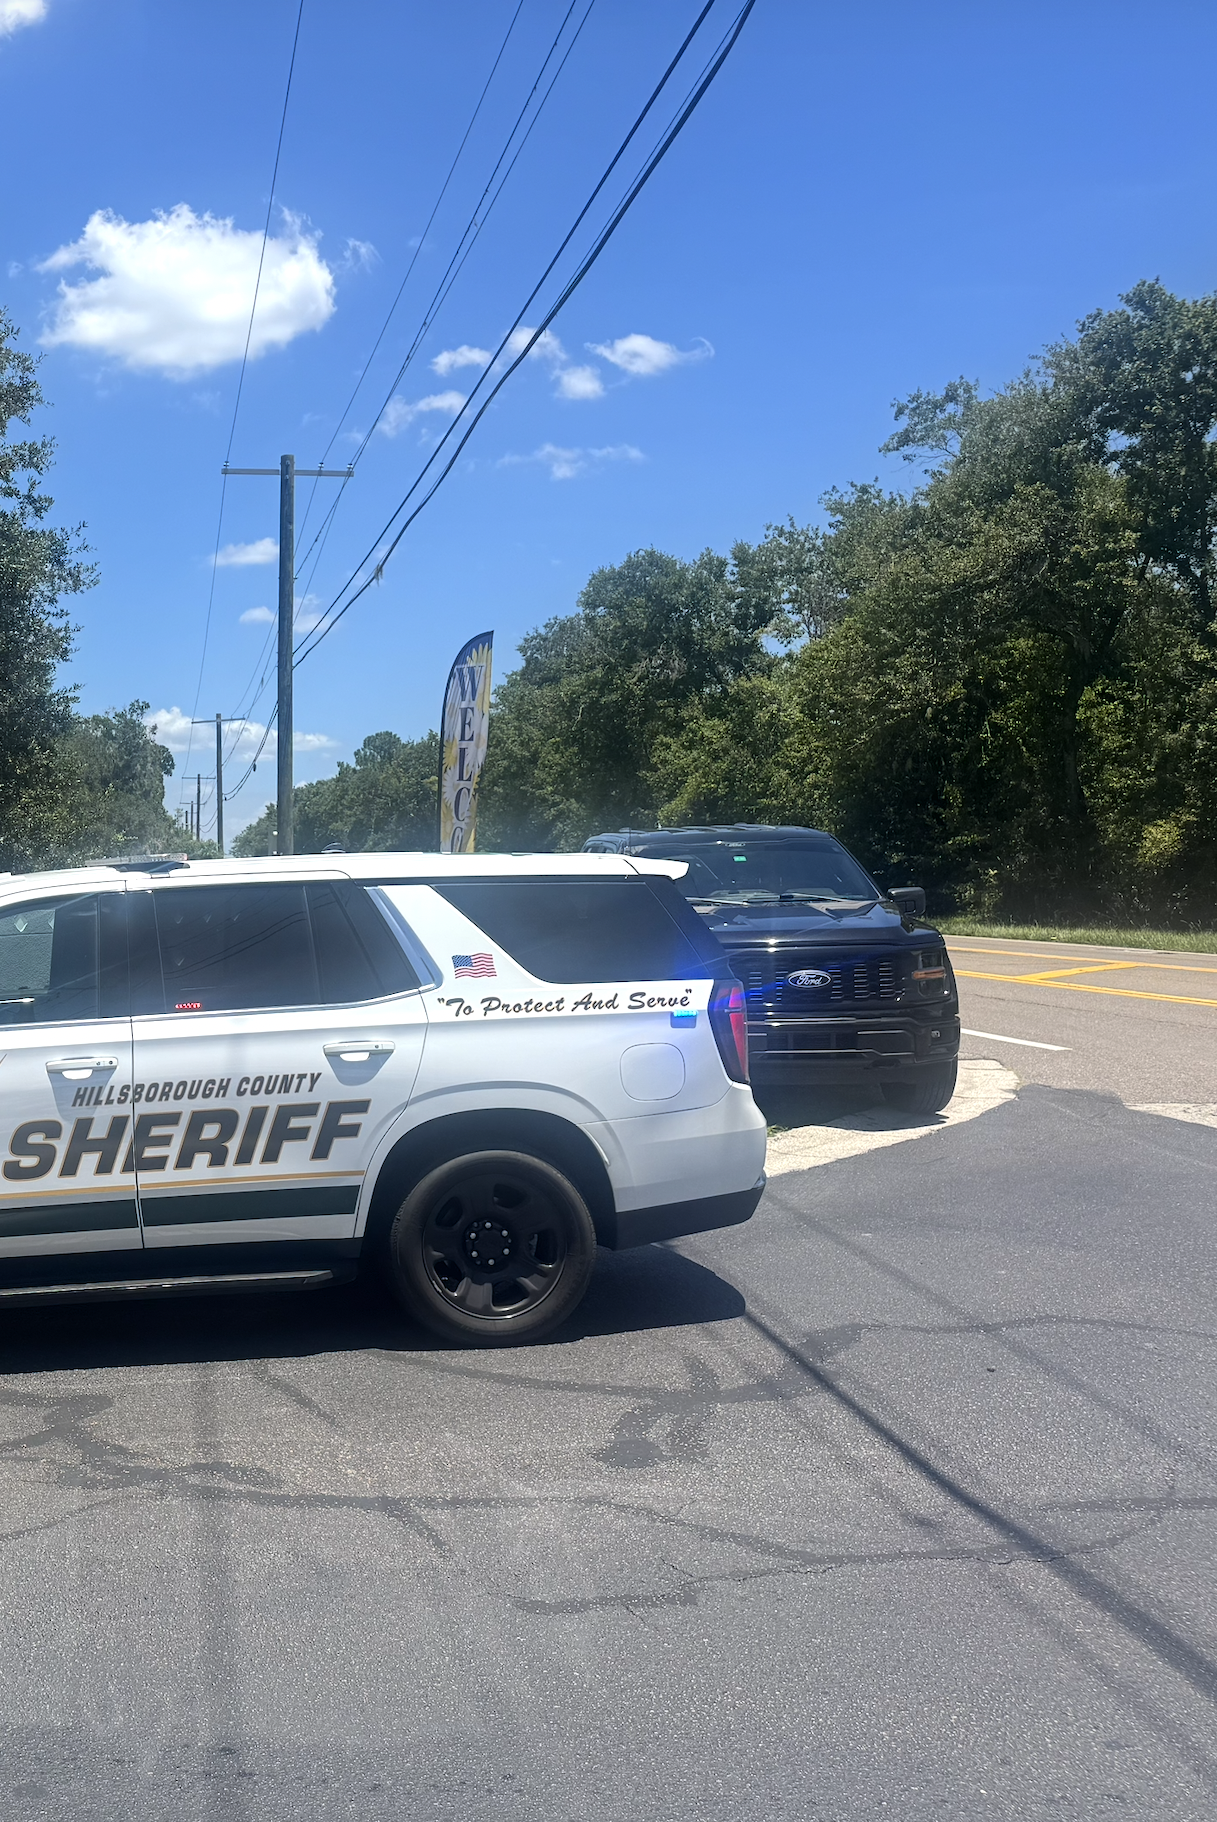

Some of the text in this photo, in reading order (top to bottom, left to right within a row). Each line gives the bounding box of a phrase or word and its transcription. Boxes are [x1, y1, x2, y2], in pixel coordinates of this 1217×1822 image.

[437, 988, 693, 1017] "To Protect And Serve"
[71, 1072, 322, 1107] HILLSBOROUGH COUNTY
[1, 1098, 372, 1182] SHERIFF
